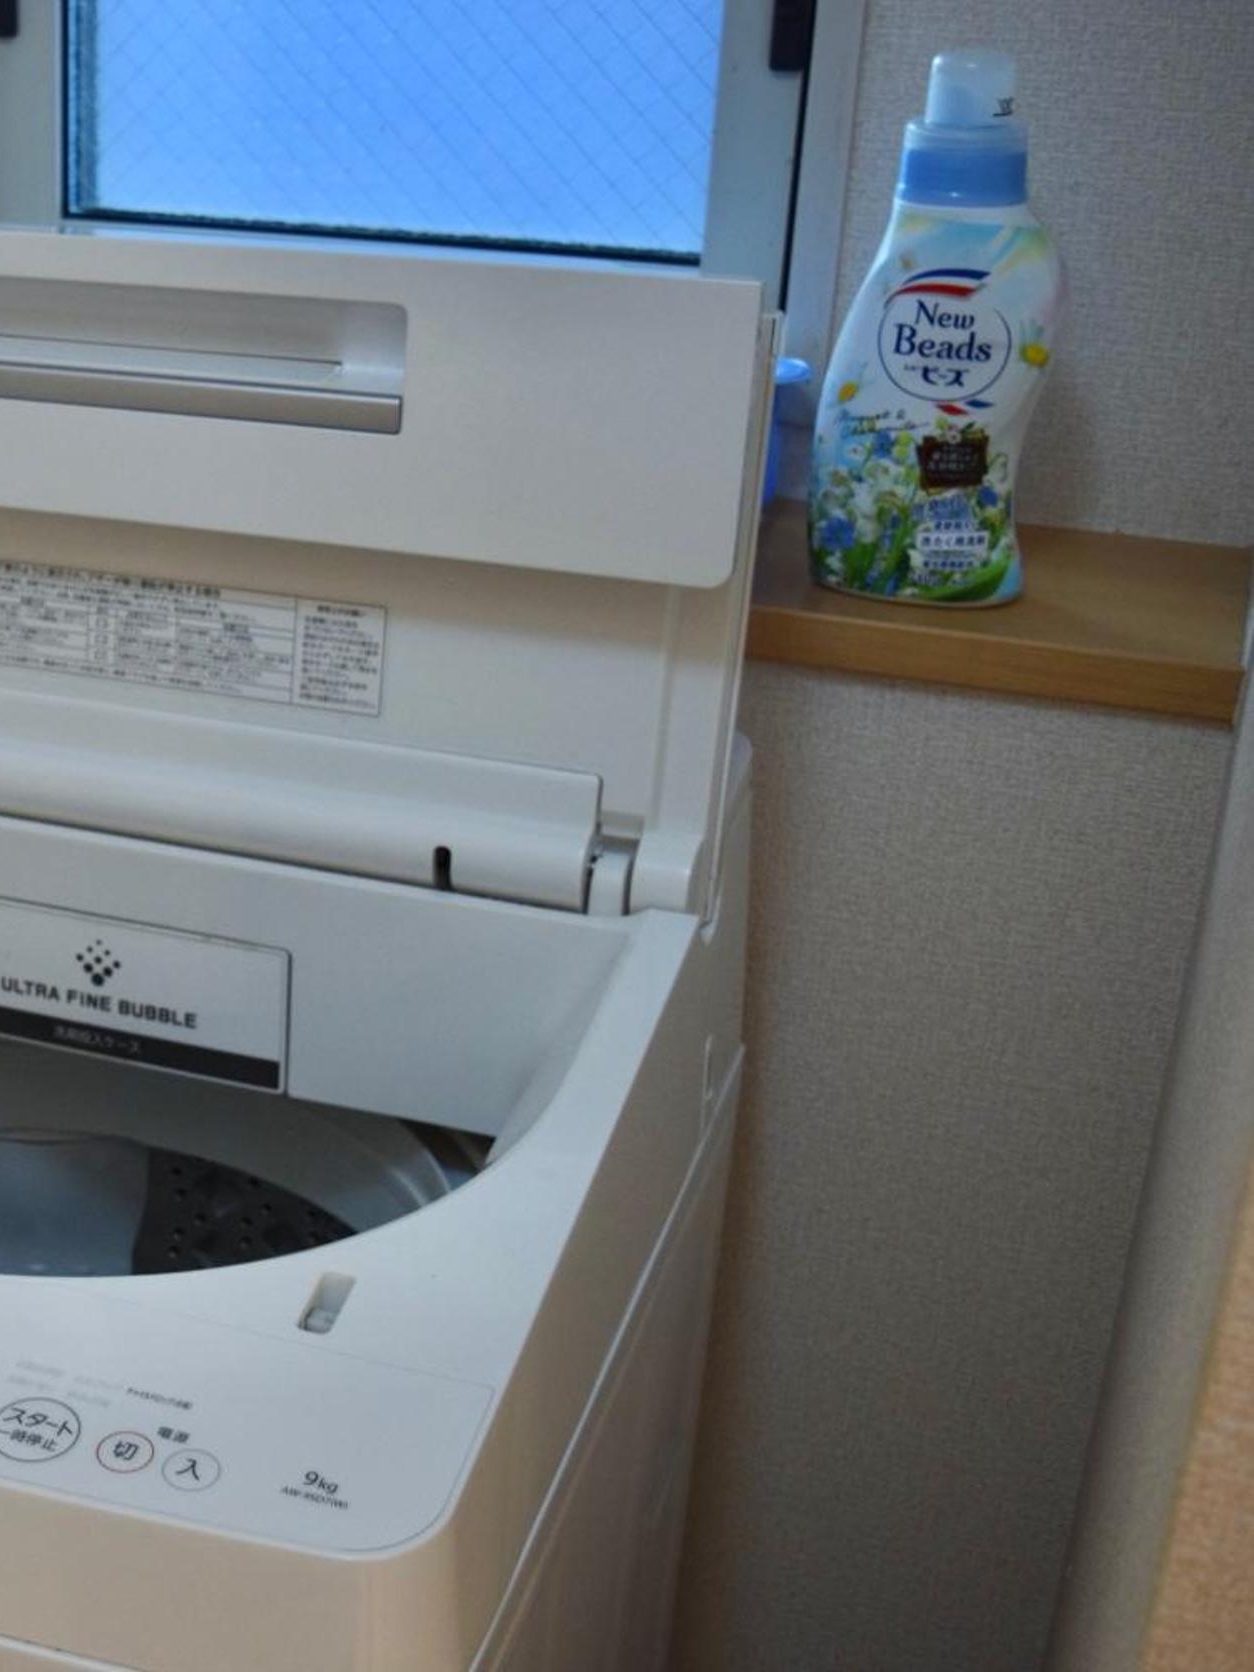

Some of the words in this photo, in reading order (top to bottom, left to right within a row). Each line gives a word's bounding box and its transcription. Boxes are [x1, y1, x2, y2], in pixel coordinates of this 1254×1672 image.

[915, 300, 976, 330] New
[893, 323, 992, 362] Beads
[0, 975, 60, 1002] ULTRA
[66, 988, 111, 1012] FINE
[118, 998, 198, 1029] BUBBLE
[2, 1406, 75, 1437] スタート
[156, 1425, 192, 1445] 電源
[112, 1440, 140, 1461] 切
[174, 1458, 203, 1481] 入
[302, 1470, 339, 1495] 9kg
